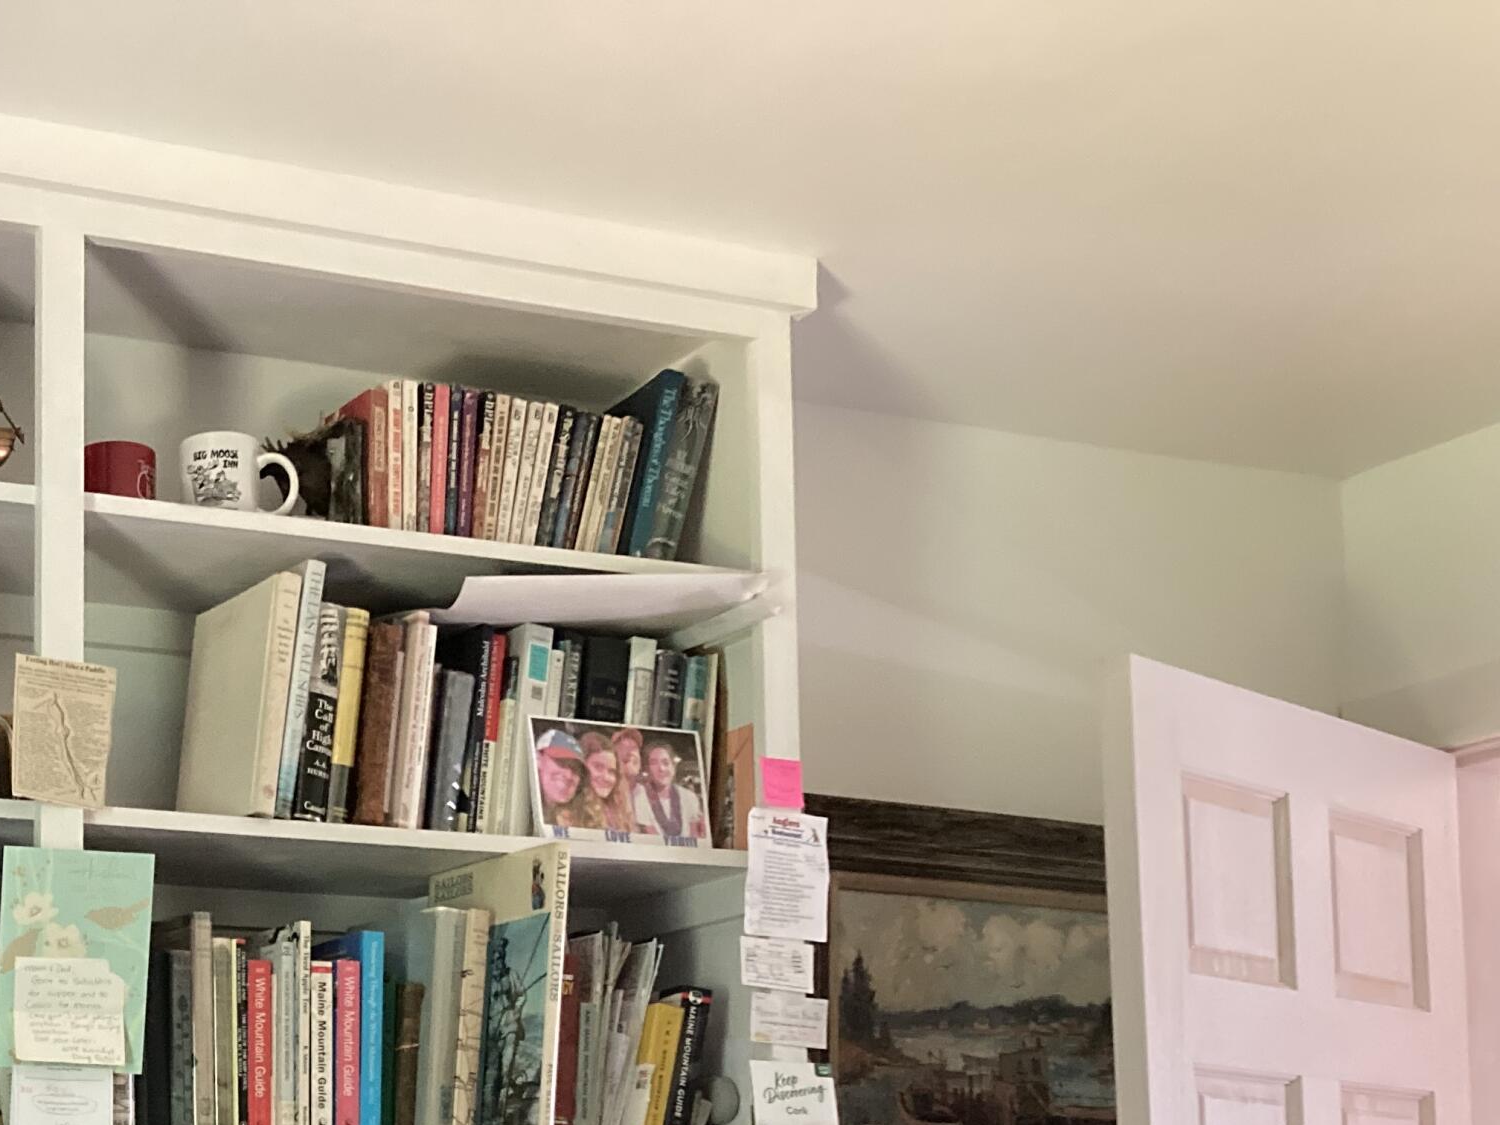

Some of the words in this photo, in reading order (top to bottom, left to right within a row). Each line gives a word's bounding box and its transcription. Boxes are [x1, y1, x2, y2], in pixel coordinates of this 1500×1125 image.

[210, 449, 238, 459] MOOSE
[308, 571, 322, 596] THE
[303, 601, 318, 635] LAST
[298, 643, 312, 674] TALL
[478, 640, 491, 678] Archibald
[318, 699, 334, 711] The
[476, 681, 487, 716] Malcolm
[315, 709, 334, 722] Call
[554, 826, 569, 838] WE
[606, 829, 631, 843] LOVE
[553, 851, 567, 919] SAILORS
[548, 933, 561, 1002] SAILORS
[254, 977, 265, 1008] White
[317, 981, 326, 1015] Maine
[342, 976, 355, 1007] White
[342, 1010, 355, 1060] Mountain
[685, 1005, 696, 1035] MAINE
[254, 1012, 265, 1062] Mountain
[317, 1020, 326, 1072] Mountain
[677, 1037, 692, 1086] MOUNTAIN
[254, 1065, 265, 1097] Guide
[317, 1077, 326, 1109] Guide
[342, 1063, 355, 1096] Guide
[774, 1072, 798, 1088] Keep
[673, 1088, 685, 1117] GUIDE
